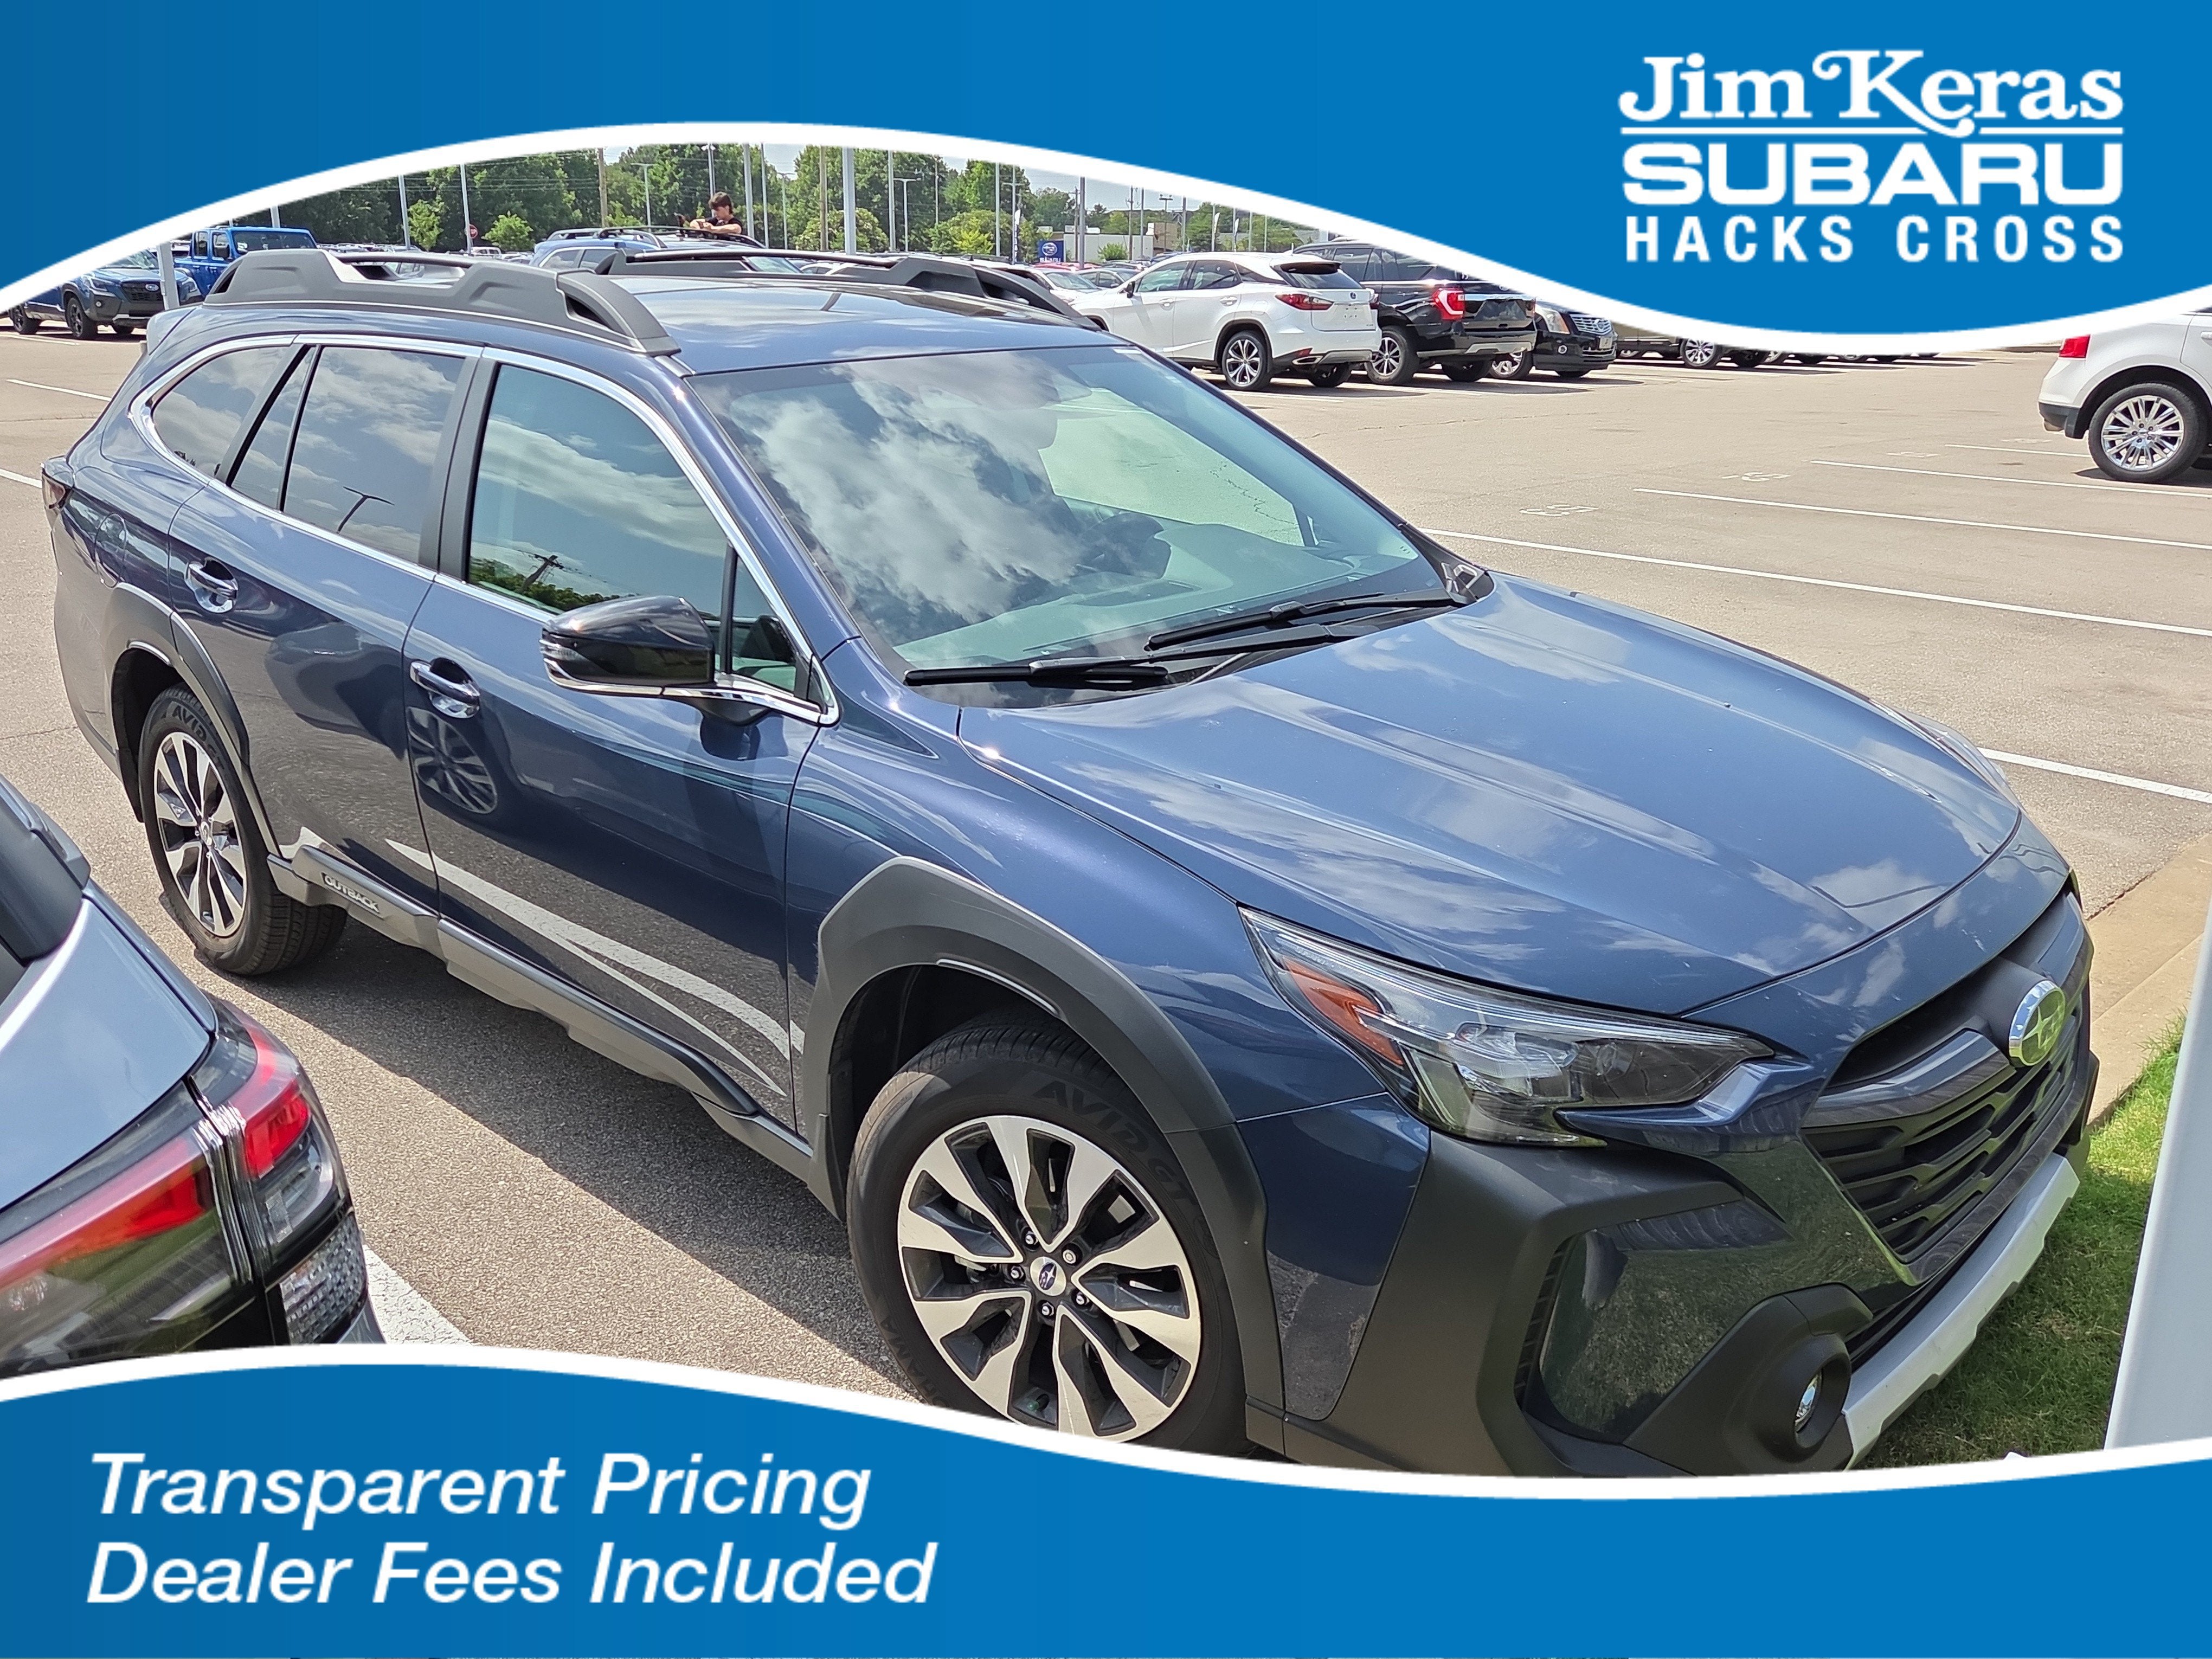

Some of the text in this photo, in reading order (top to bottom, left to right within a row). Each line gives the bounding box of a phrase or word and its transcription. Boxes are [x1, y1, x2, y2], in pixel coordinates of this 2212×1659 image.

[172, 705, 207, 741] AVID
[324, 874, 380, 914] OUTBACK
[1032, 1080, 1149, 1152] AVID
